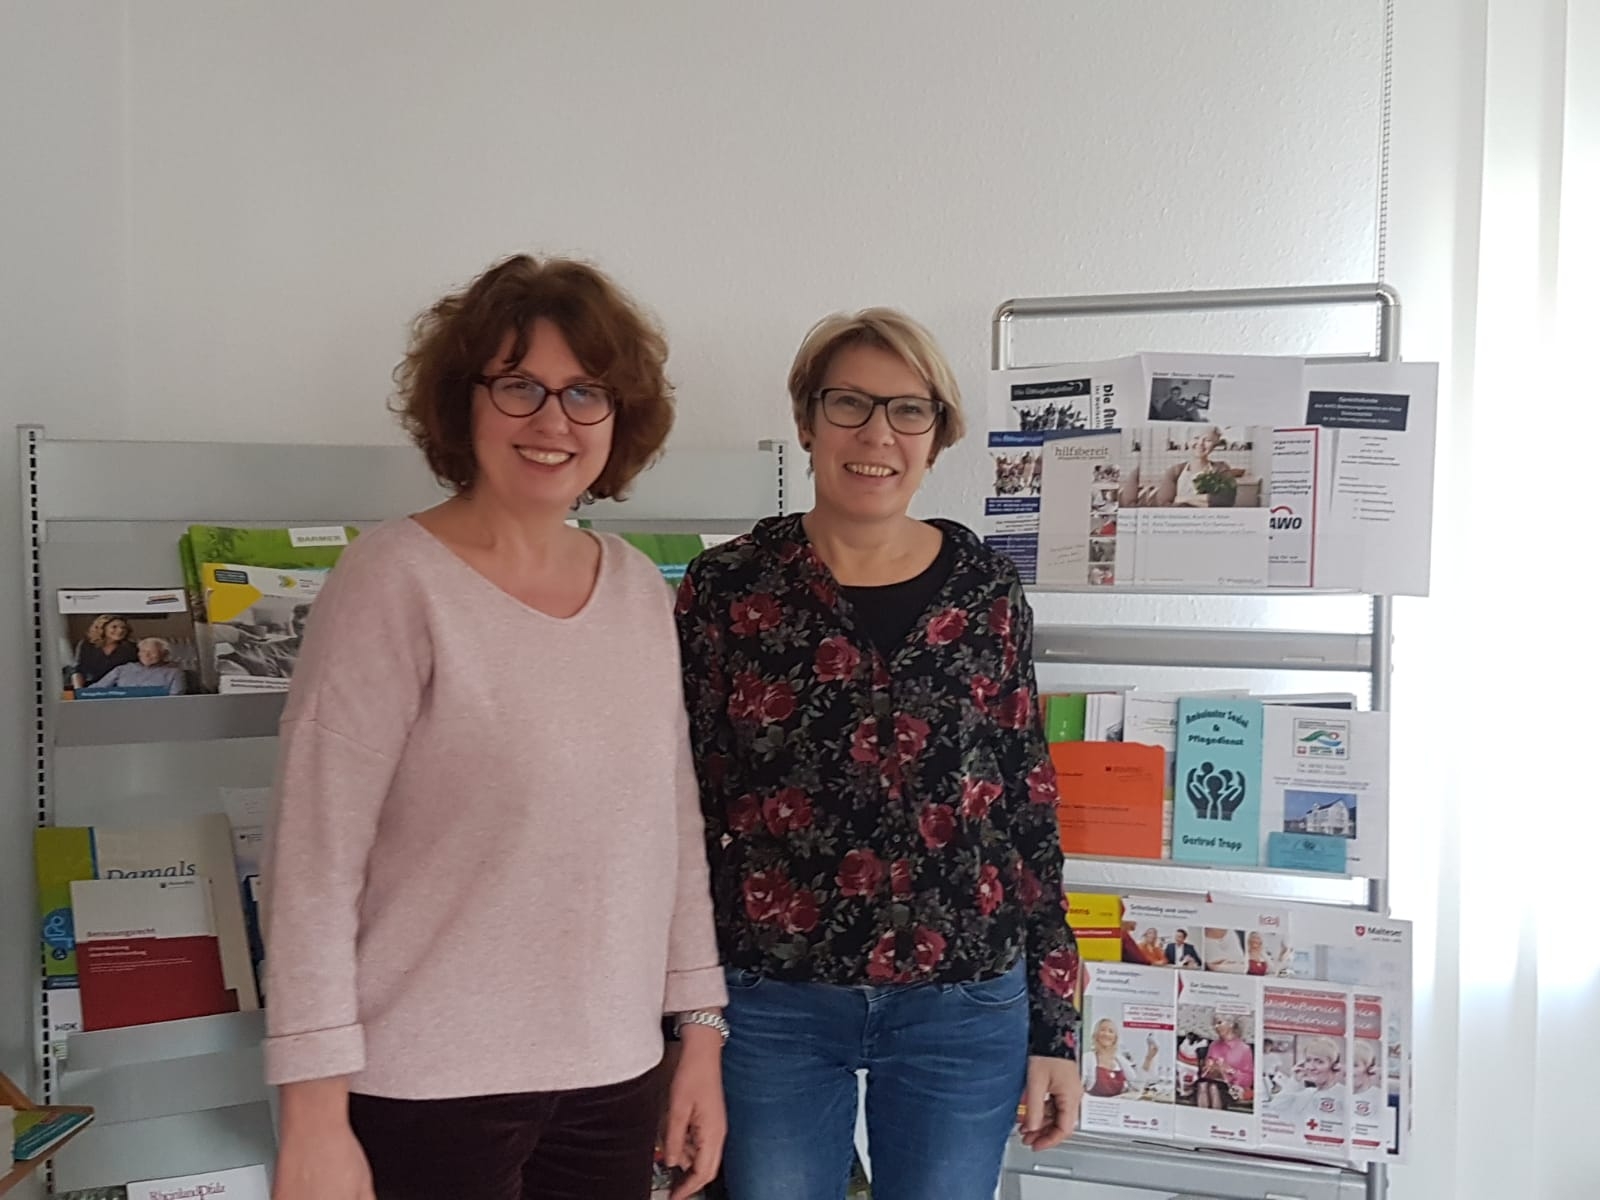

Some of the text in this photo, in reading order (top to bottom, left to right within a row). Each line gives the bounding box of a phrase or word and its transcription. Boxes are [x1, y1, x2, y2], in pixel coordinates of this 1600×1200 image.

[1103, 384, 1114, 404] Die
[1055, 446, 1109, 457] hilfsbereit
[1269, 517, 1302, 529] AWO
[1213, 724, 1220, 732] &
[1188, 734, 1244, 746] Pflegedienst
[1182, 835, 1216, 847] Gertrud
[107, 861, 196, 880] Damals
[1368, 926, 1402, 937] Malteser
